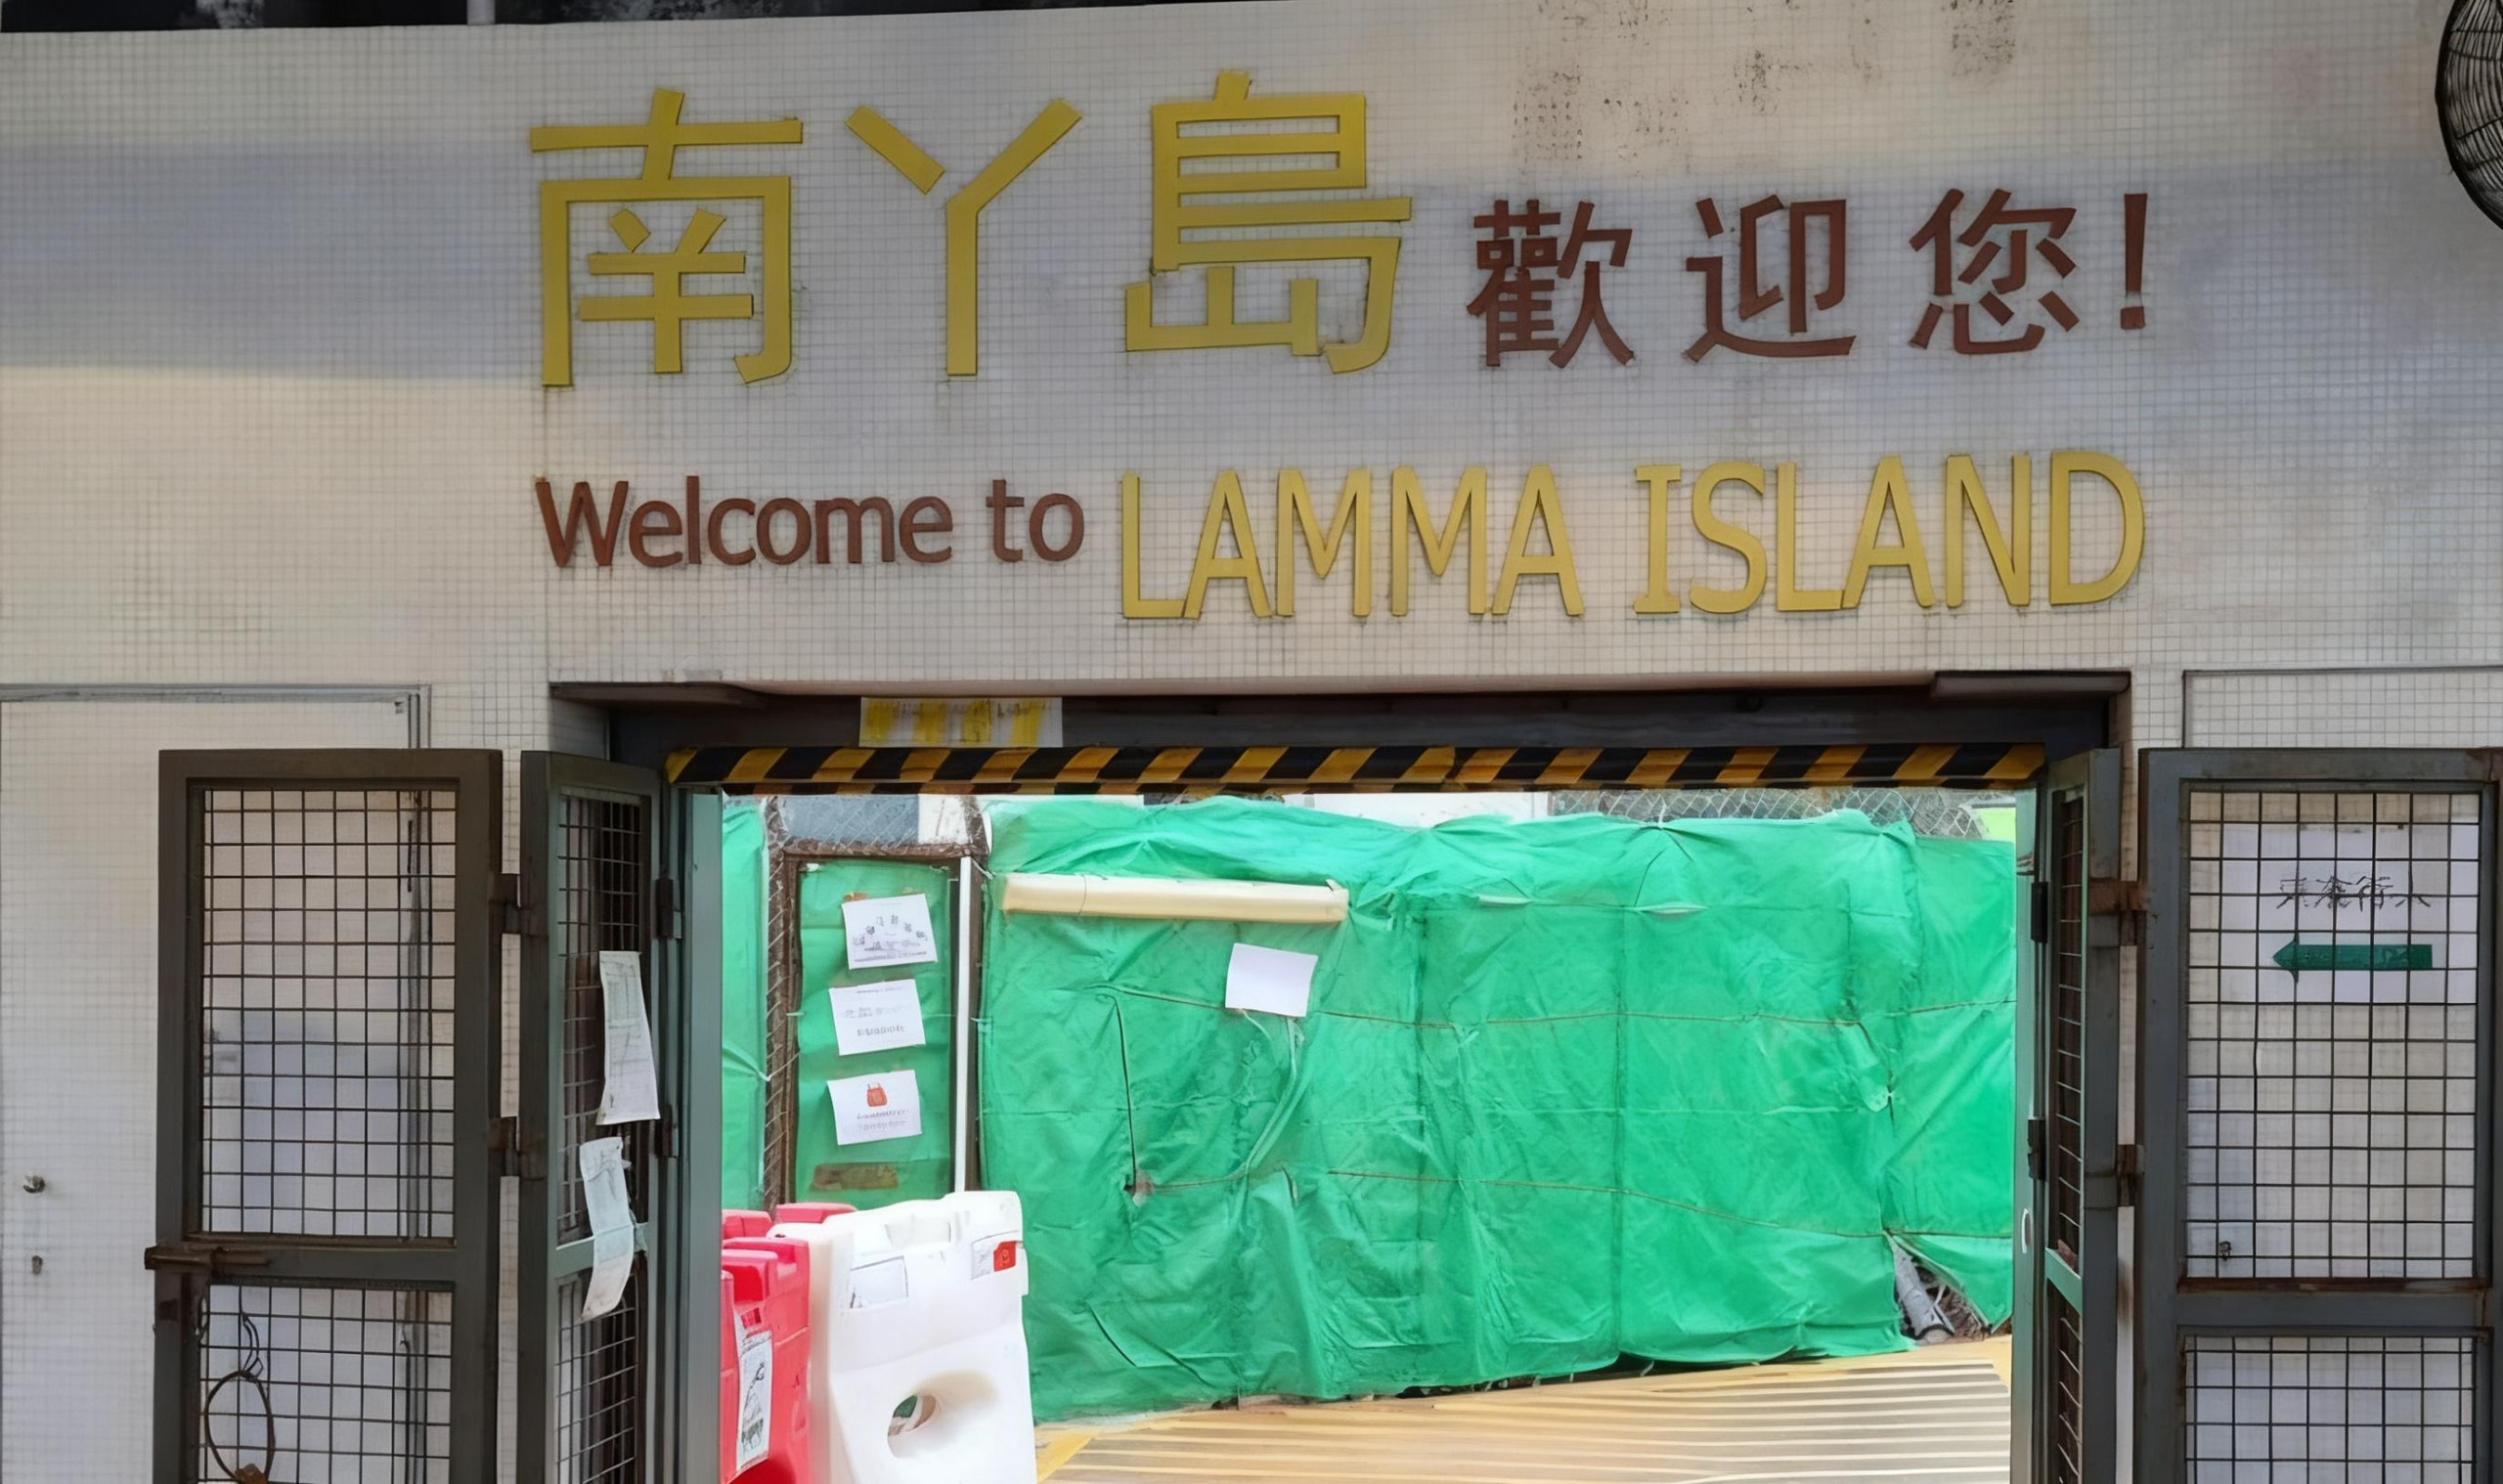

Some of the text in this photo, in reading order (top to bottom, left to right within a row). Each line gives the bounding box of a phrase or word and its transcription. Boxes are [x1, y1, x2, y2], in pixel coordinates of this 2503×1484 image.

[529, 68, 1412, 387] 南丫島
[533, 450, 2146, 620] Welcome to LAMMA ISLAND
